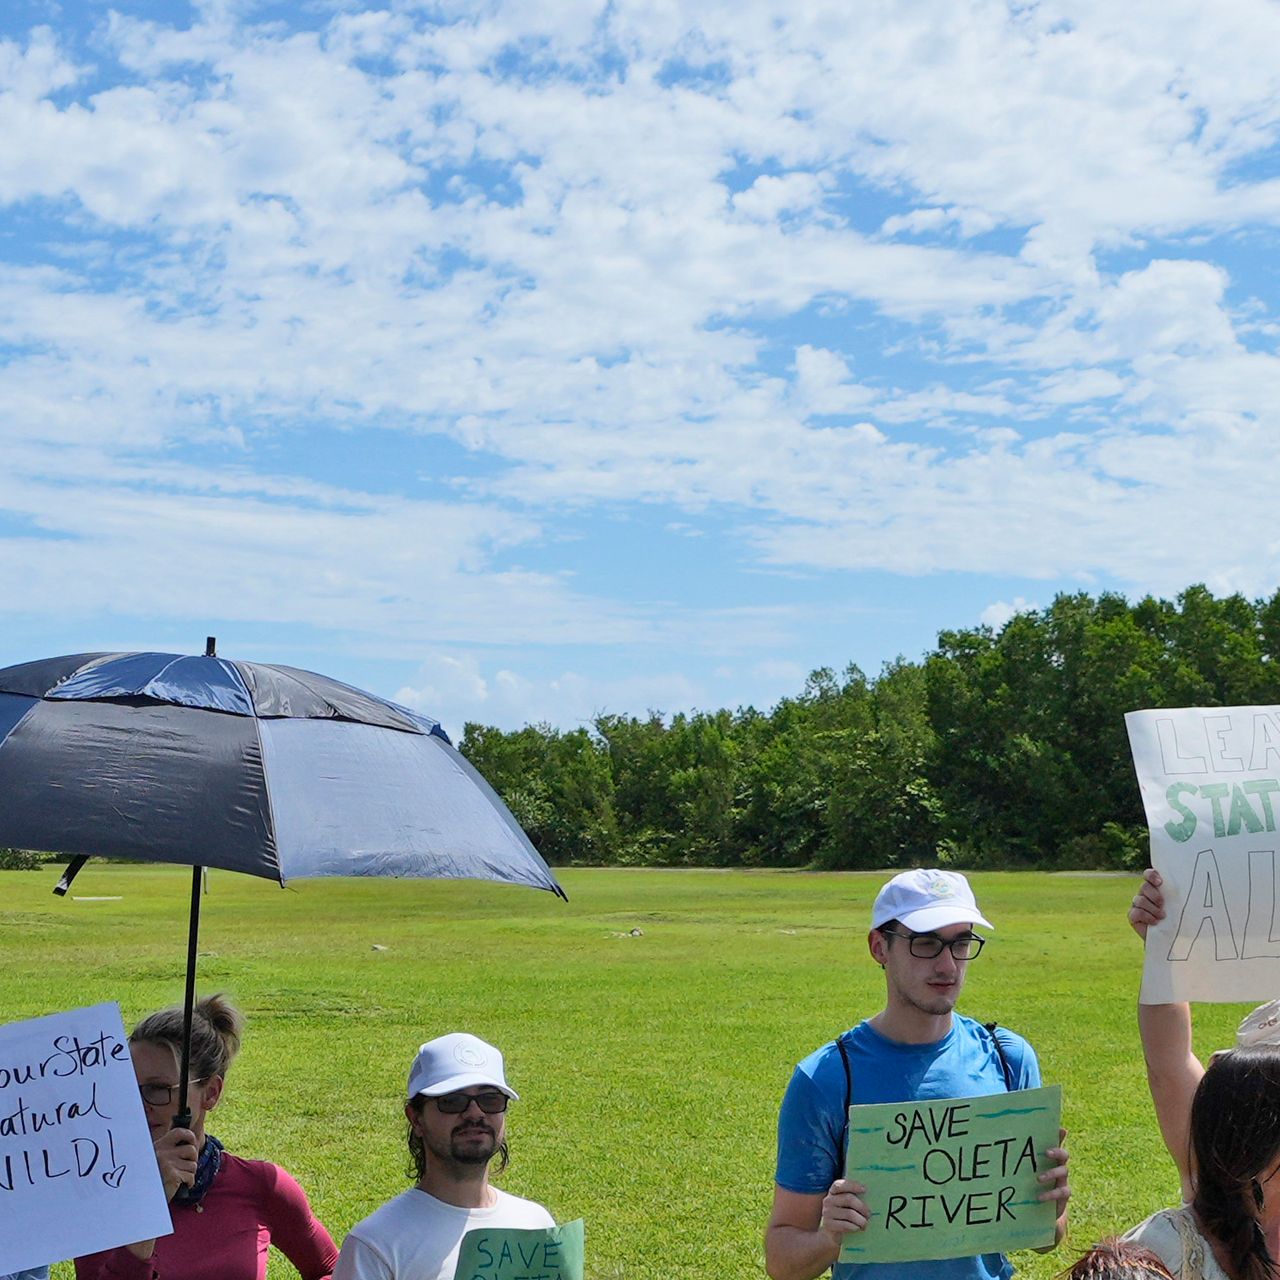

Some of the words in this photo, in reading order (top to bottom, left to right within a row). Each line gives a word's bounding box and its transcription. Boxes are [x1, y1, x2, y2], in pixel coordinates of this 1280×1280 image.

[52, 1030, 131, 1078] State
[885, 1104, 972, 1150] SAVE
[922, 1135, 1039, 1186] OLETA
[884, 1185, 1018, 1231] RIVER
[476, 1238, 563, 1269] SAVE
